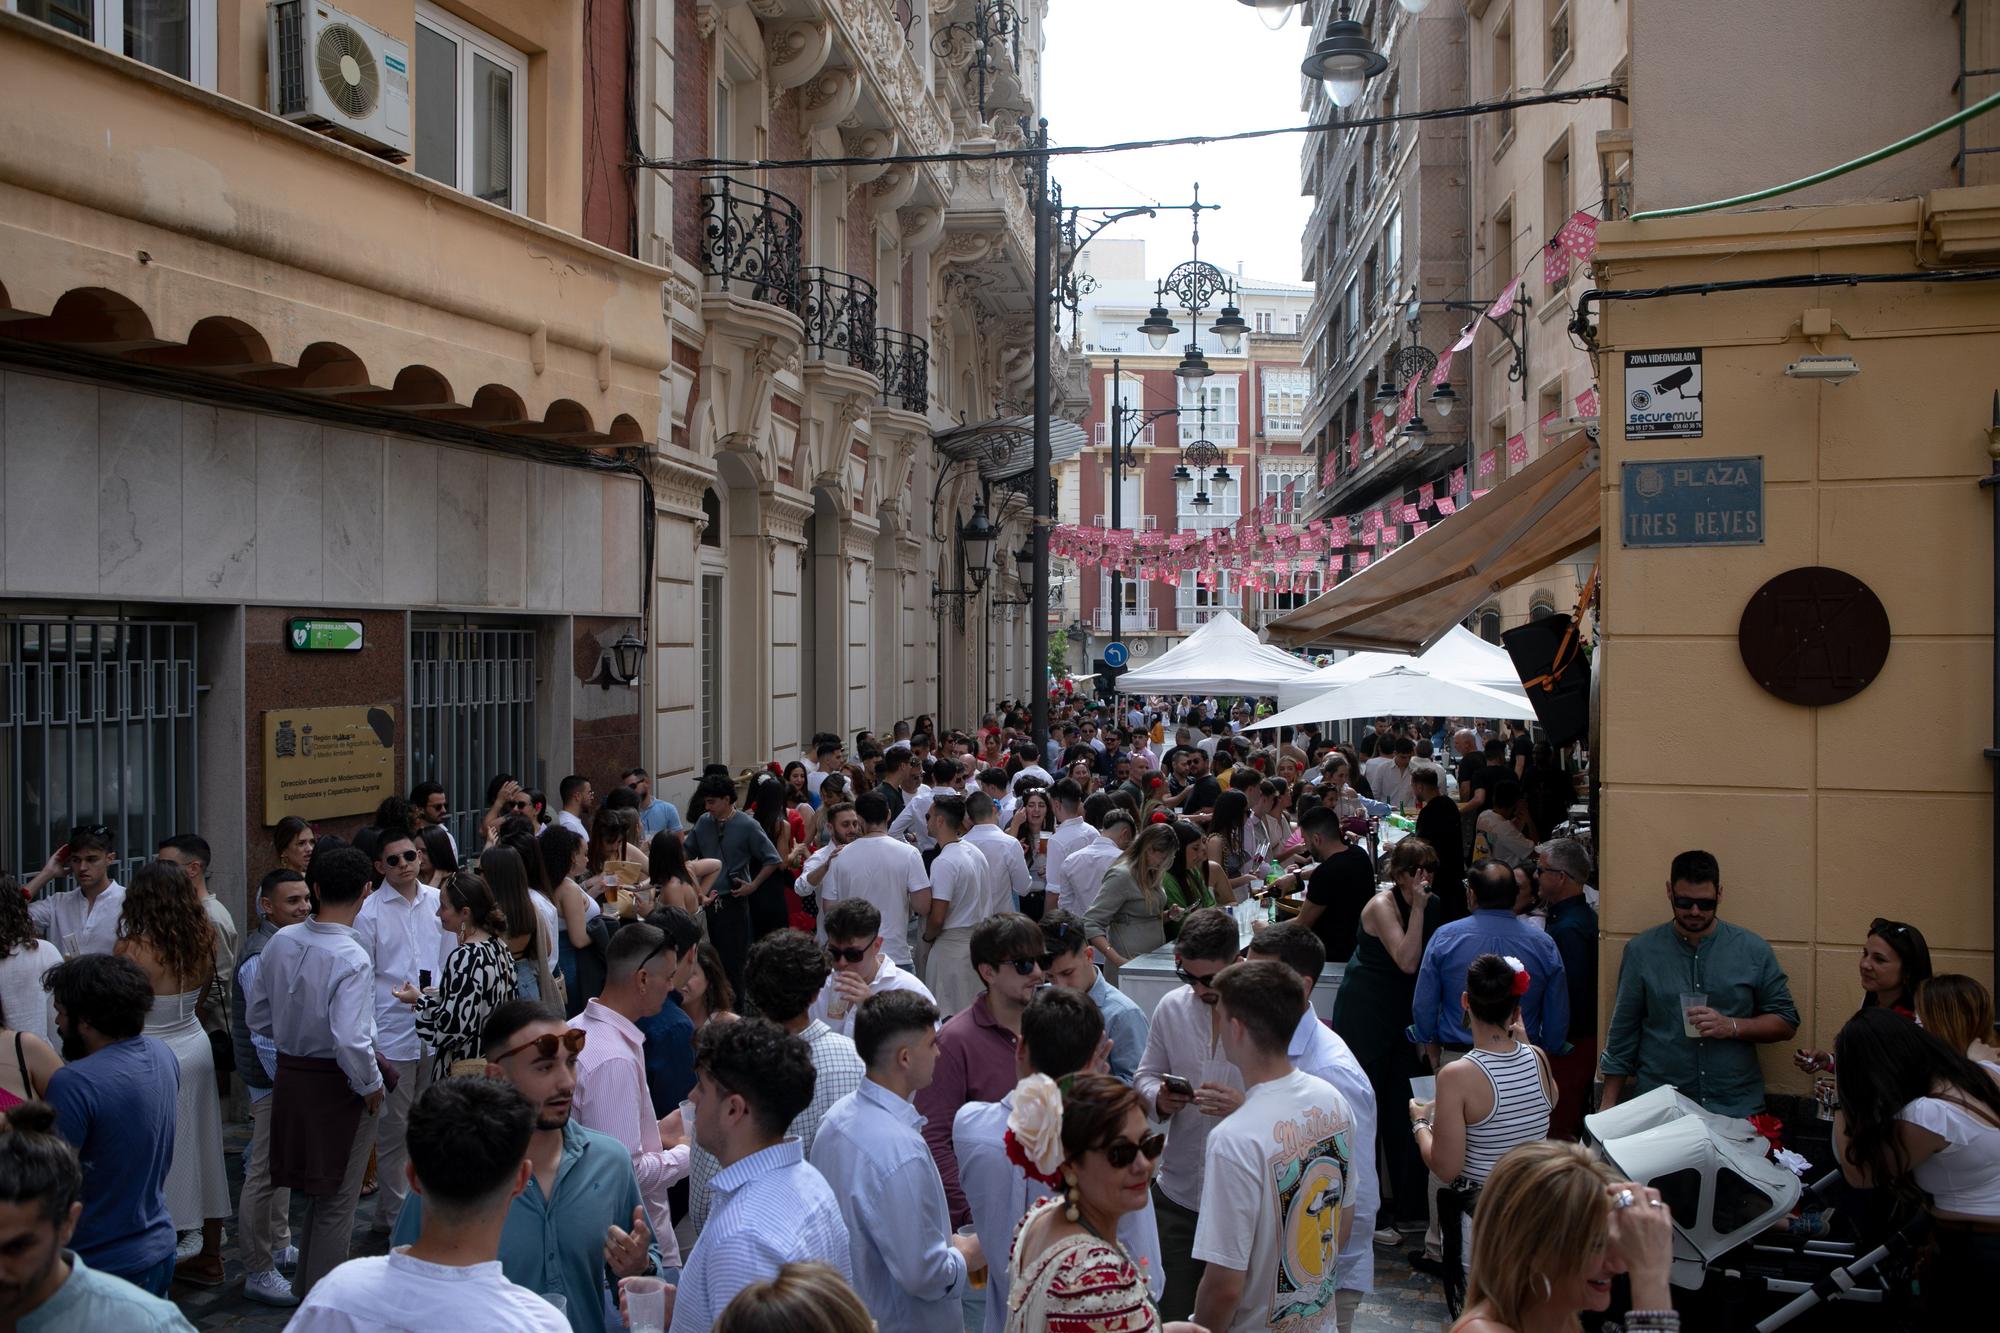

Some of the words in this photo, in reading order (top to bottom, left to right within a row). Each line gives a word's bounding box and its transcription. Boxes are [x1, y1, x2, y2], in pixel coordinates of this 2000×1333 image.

[1630, 354, 1647, 365] ZONA
[1648, 352, 1697, 364] VIDEOVIGILADA
[1630, 411, 1698, 423] securemur
[1673, 466, 1749, 487] PLAZA
[1629, 512, 1677, 537] TRES
[1695, 510, 1757, 536] REYES
[308, 777, 330, 785] General
